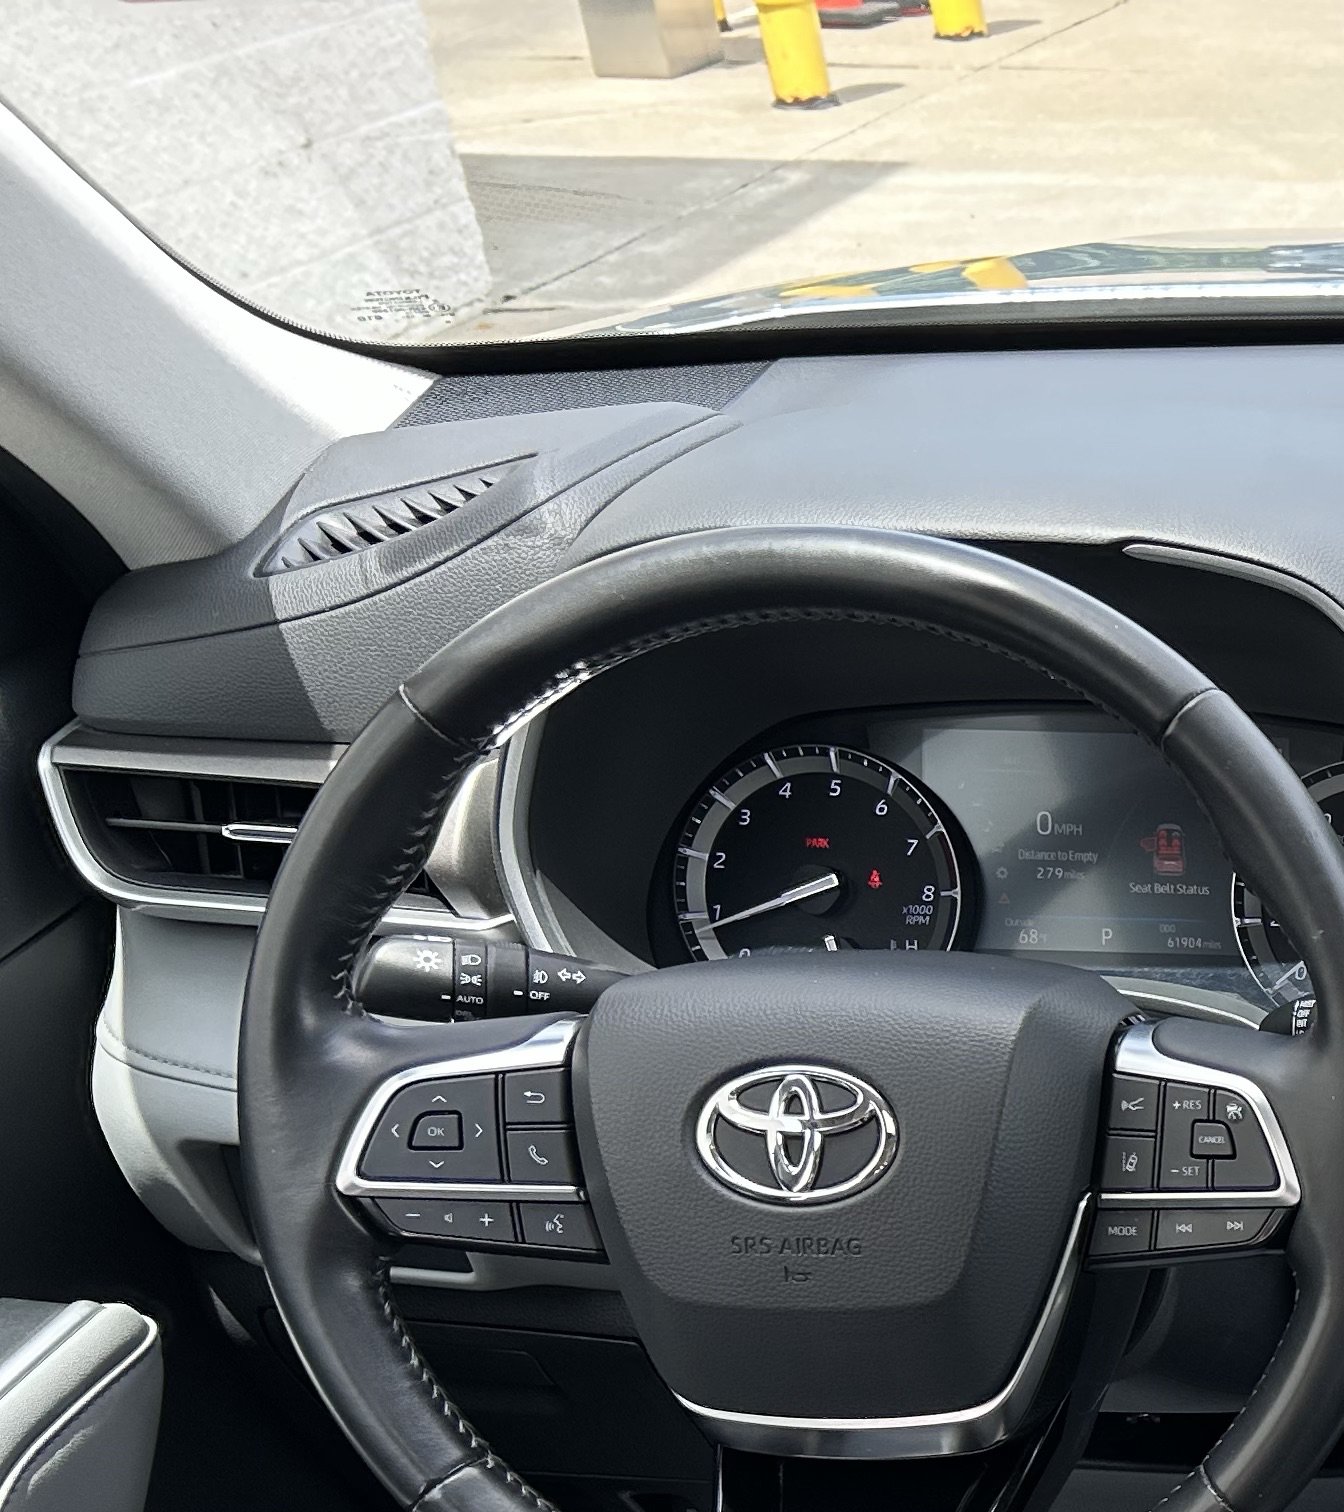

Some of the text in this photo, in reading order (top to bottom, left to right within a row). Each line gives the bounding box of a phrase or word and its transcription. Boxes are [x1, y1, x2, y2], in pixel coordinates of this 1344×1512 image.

[778, 782, 792, 799] 4
[829, 779, 841, 796] 5
[875, 800, 888, 816] 6
[738, 809, 751, 825] 3
[1036, 811, 1082, 836] 0 MPH
[805, 838, 830, 848] PARK
[907, 839, 919, 856] 7
[713, 852, 726, 869] 2
[1018, 849, 1098, 864] Distance to Empty
[1036, 867, 1063, 879] 279
[922, 885, 935, 901] 8
[1129, 882, 1210, 895] Seat Belt Status
[905, 915, 930, 925] RPM
[1101, 928, 1112, 945] P
[1167, 937, 1201, 948] 61904
[456, 995, 484, 1005] AUTO
[530, 991, 550, 1001] OFF
[427, 1127, 445, 1136] OK
[1199, 1136, 1225, 1144] CANCEL
[1108, 1226, 1138, 1236] MODE
[731, 1236, 862, 1257] SRS AIRBAG
